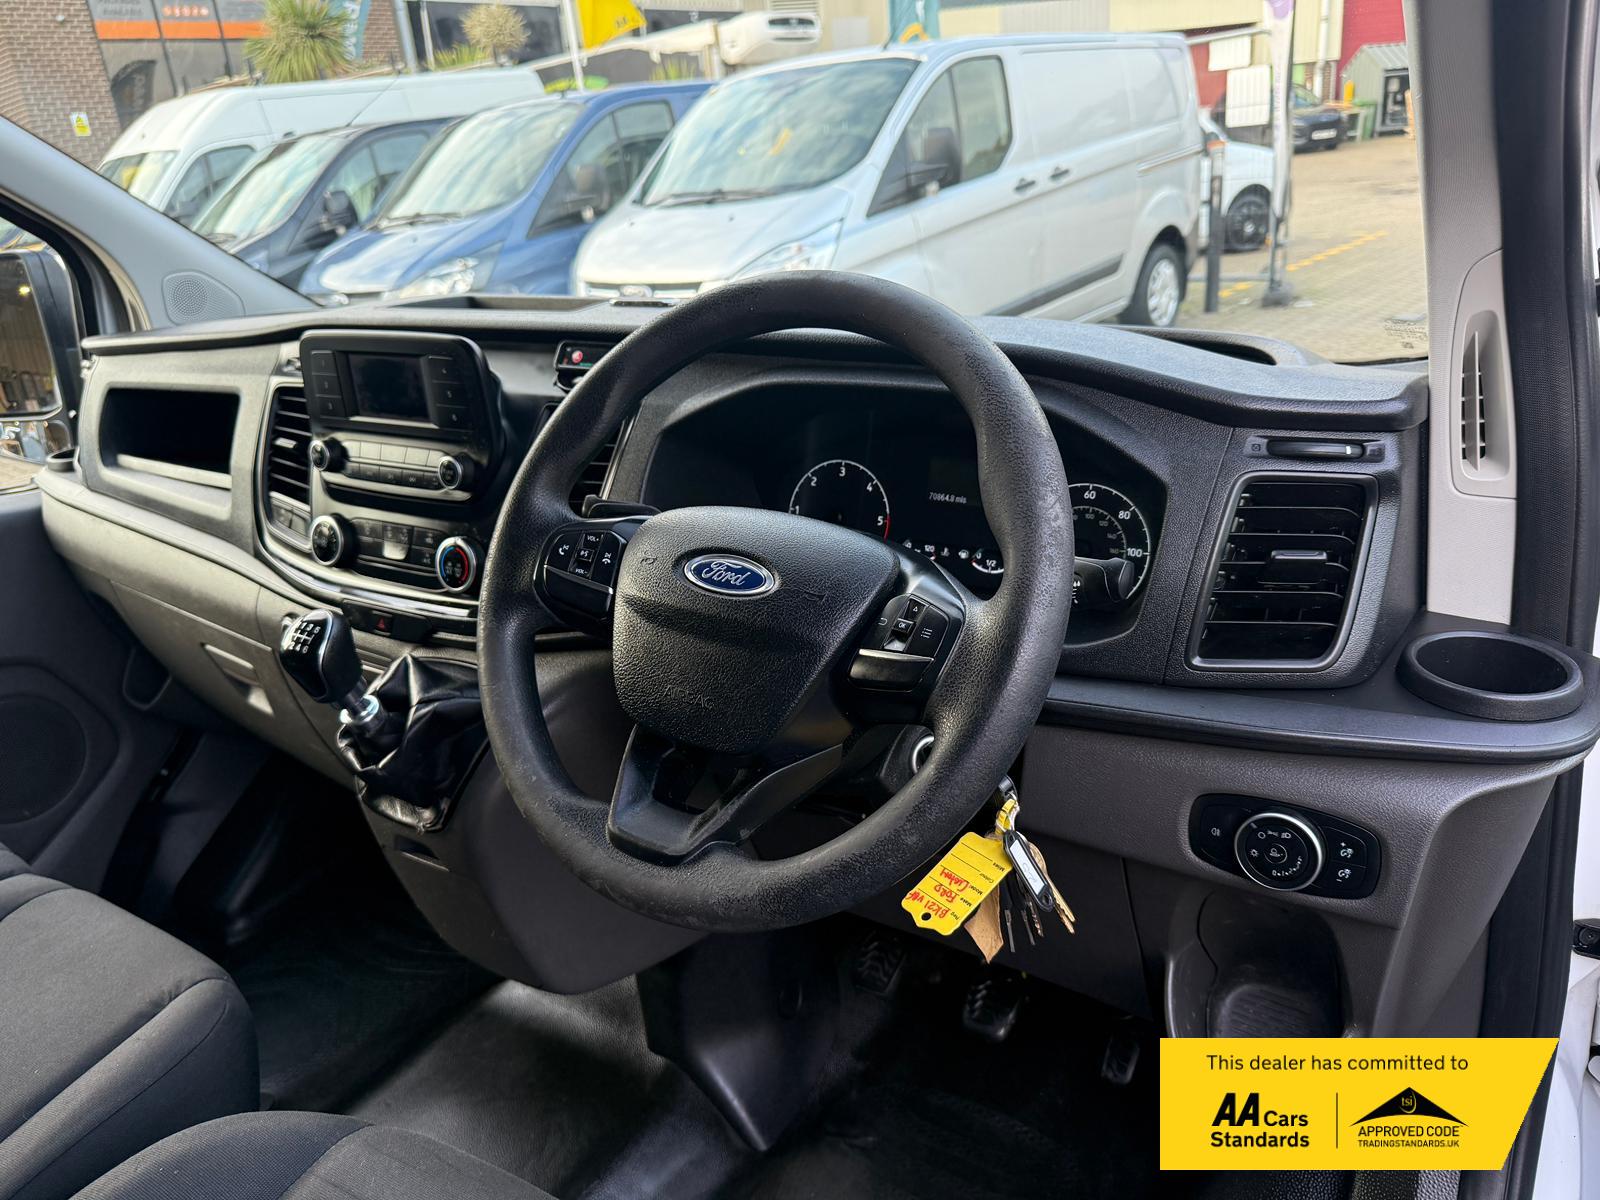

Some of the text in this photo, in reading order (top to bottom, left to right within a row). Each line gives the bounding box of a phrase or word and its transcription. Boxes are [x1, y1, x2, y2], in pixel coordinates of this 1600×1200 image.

[839, 466, 846, 477] 3
[811, 476, 817, 487] 2
[866, 482, 873, 493] 4
[1083, 490, 1097, 500] 60
[795, 505, 800, 515] 1
[1118, 510, 1131, 520] 80
[877, 515, 884, 526] 5
[924, 544, 935, 552] 120
[1126, 547, 1143, 558] 100
[986, 559, 997, 568] 1/2
[702, 561, 751, 586] Ford
[924, 900, 950, 919] BK21
